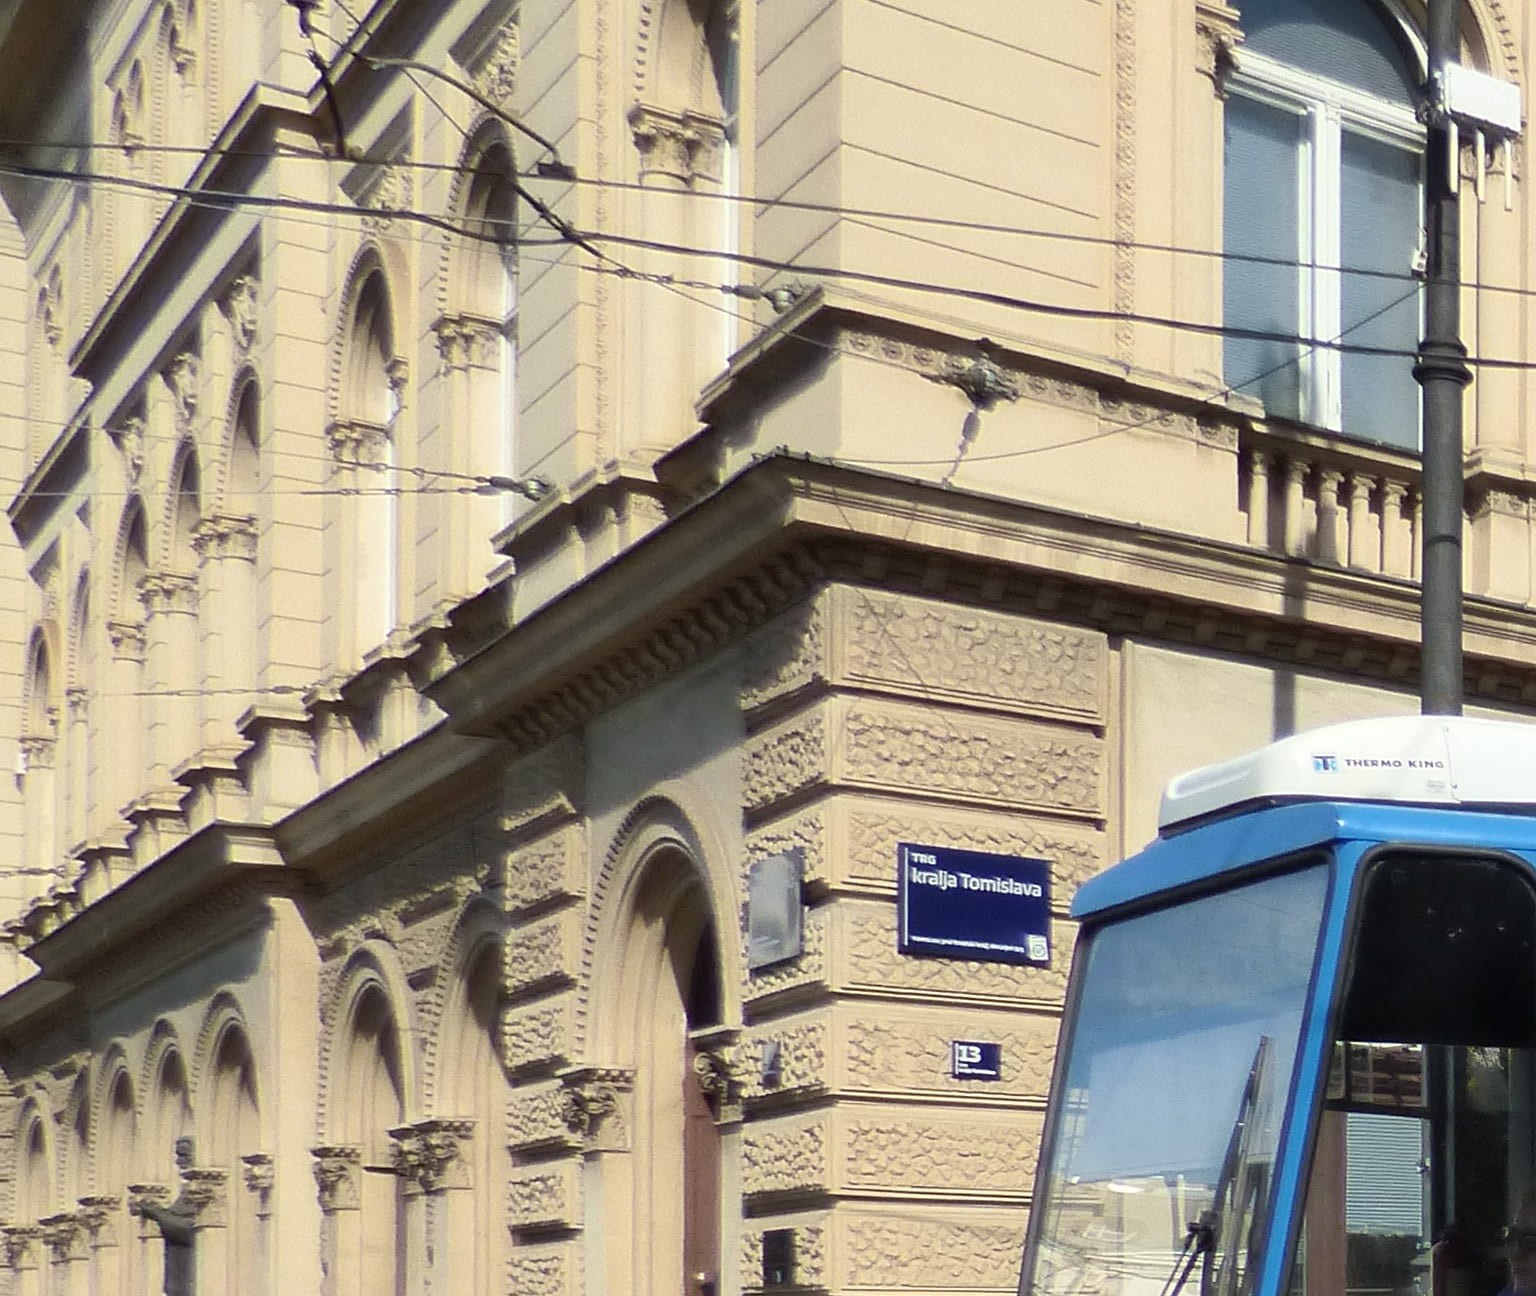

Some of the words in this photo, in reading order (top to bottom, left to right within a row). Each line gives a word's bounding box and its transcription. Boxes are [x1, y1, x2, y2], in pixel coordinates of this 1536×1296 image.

[1345, 759, 1402, 768] THERMO
[1408, 760, 1444, 769] KING
[911, 852, 937, 865] TRG
[911, 867, 958, 891] kralja
[959, 872, 1043, 897] Tomislava
[959, 1045, 981, 1063] 13
